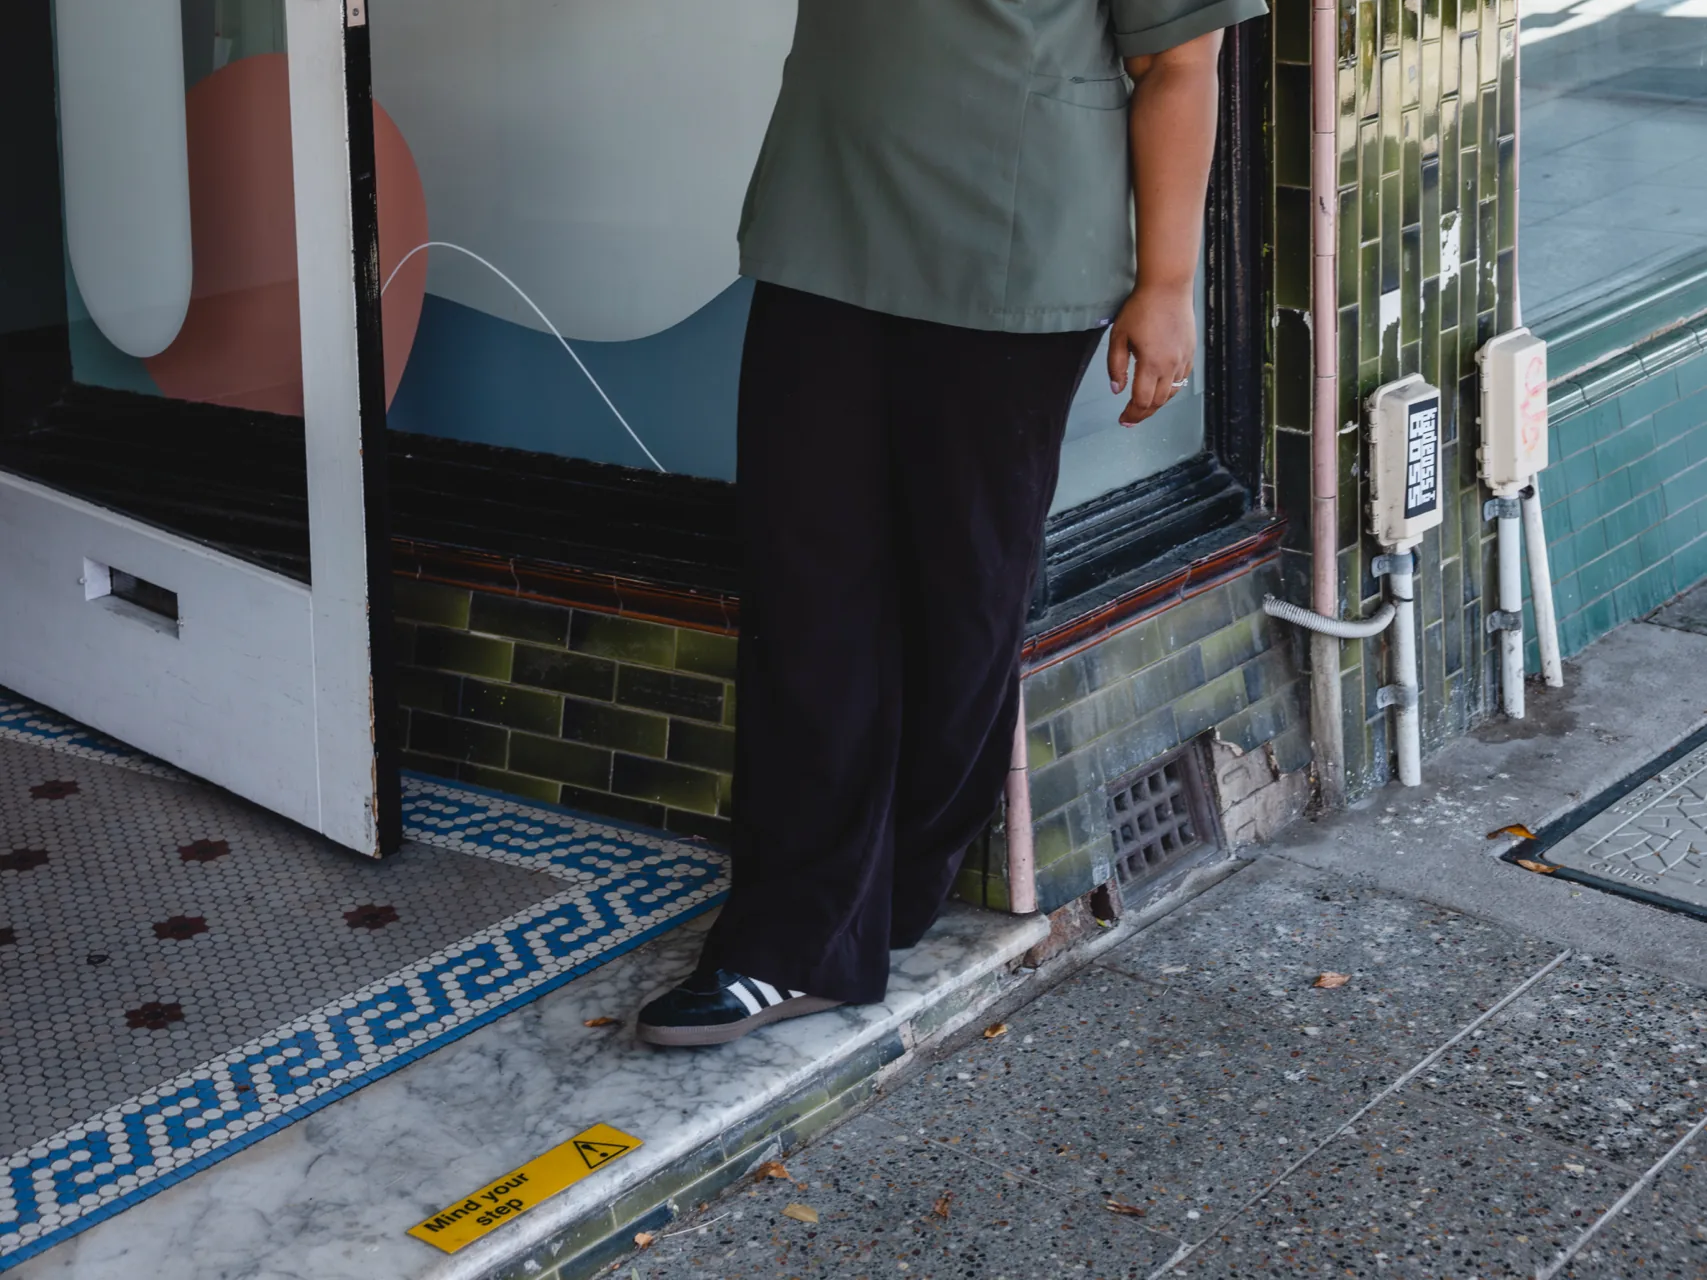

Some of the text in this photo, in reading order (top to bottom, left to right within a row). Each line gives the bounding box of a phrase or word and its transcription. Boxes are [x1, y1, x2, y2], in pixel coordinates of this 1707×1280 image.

[424, 1172, 530, 1234] Mind your
[475, 1196, 524, 1227] step
